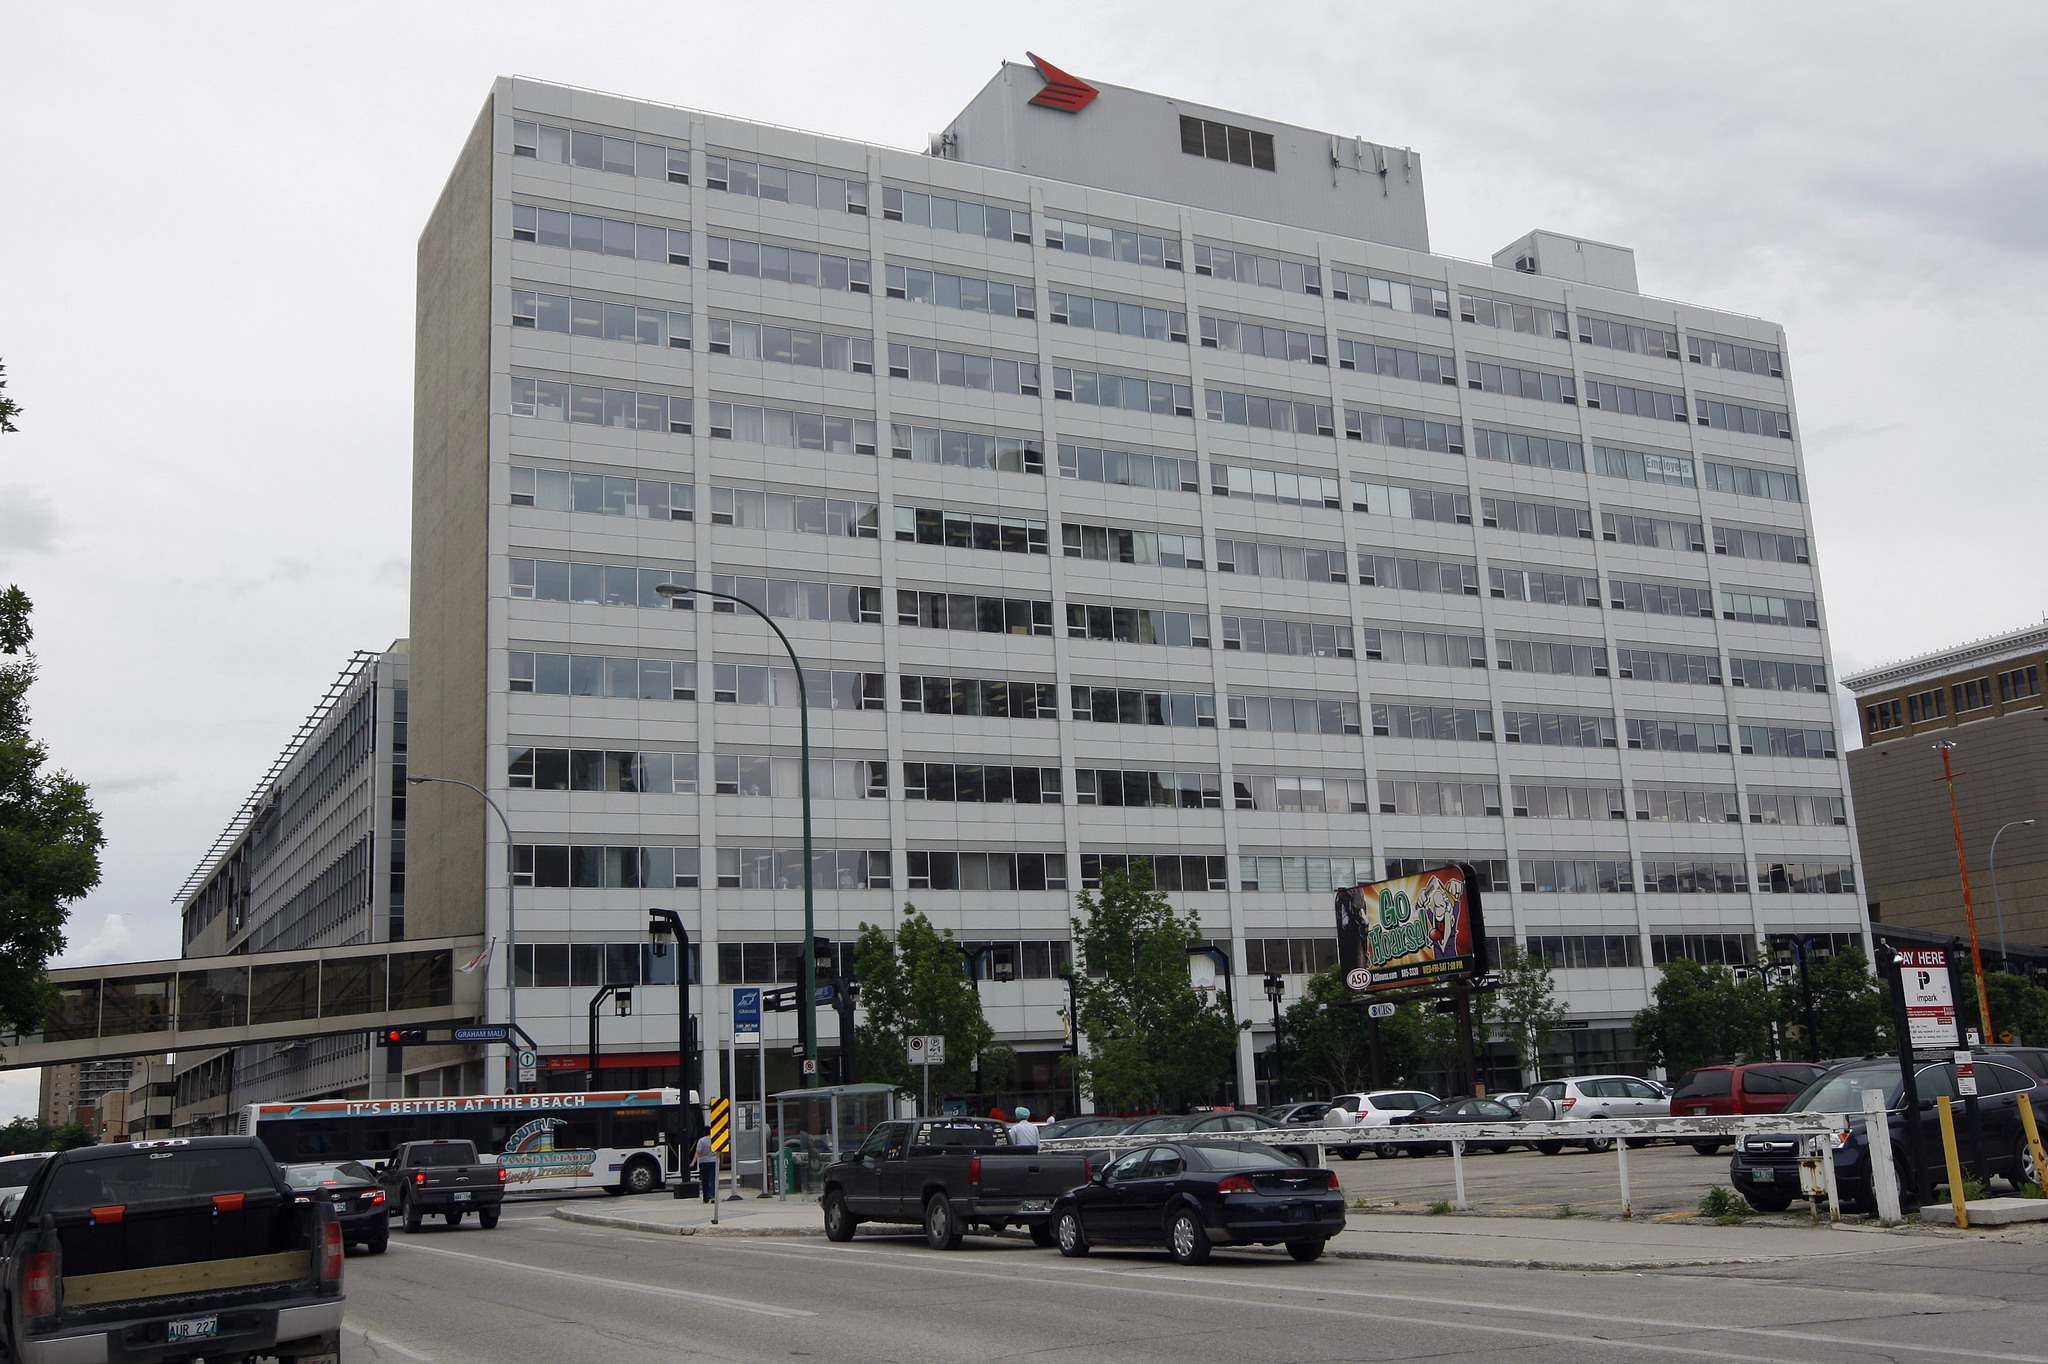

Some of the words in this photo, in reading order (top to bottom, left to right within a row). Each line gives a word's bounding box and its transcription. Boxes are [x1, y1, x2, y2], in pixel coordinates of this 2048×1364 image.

[1917, 951, 1946, 965] HERE
[1351, 971, 1368, 985] ASD
[1916, 993, 1938, 1004] impark
[346, 1103, 381, 1115] IT'S
[390, 1100, 457, 1114] BETTER
[463, 1099, 486, 1111] AT
[491, 1098, 523, 1110] THE
[530, 1096, 585, 1109] BEACH
[169, 1324, 190, 1337] AUR
[196, 1321, 216, 1334] 227
